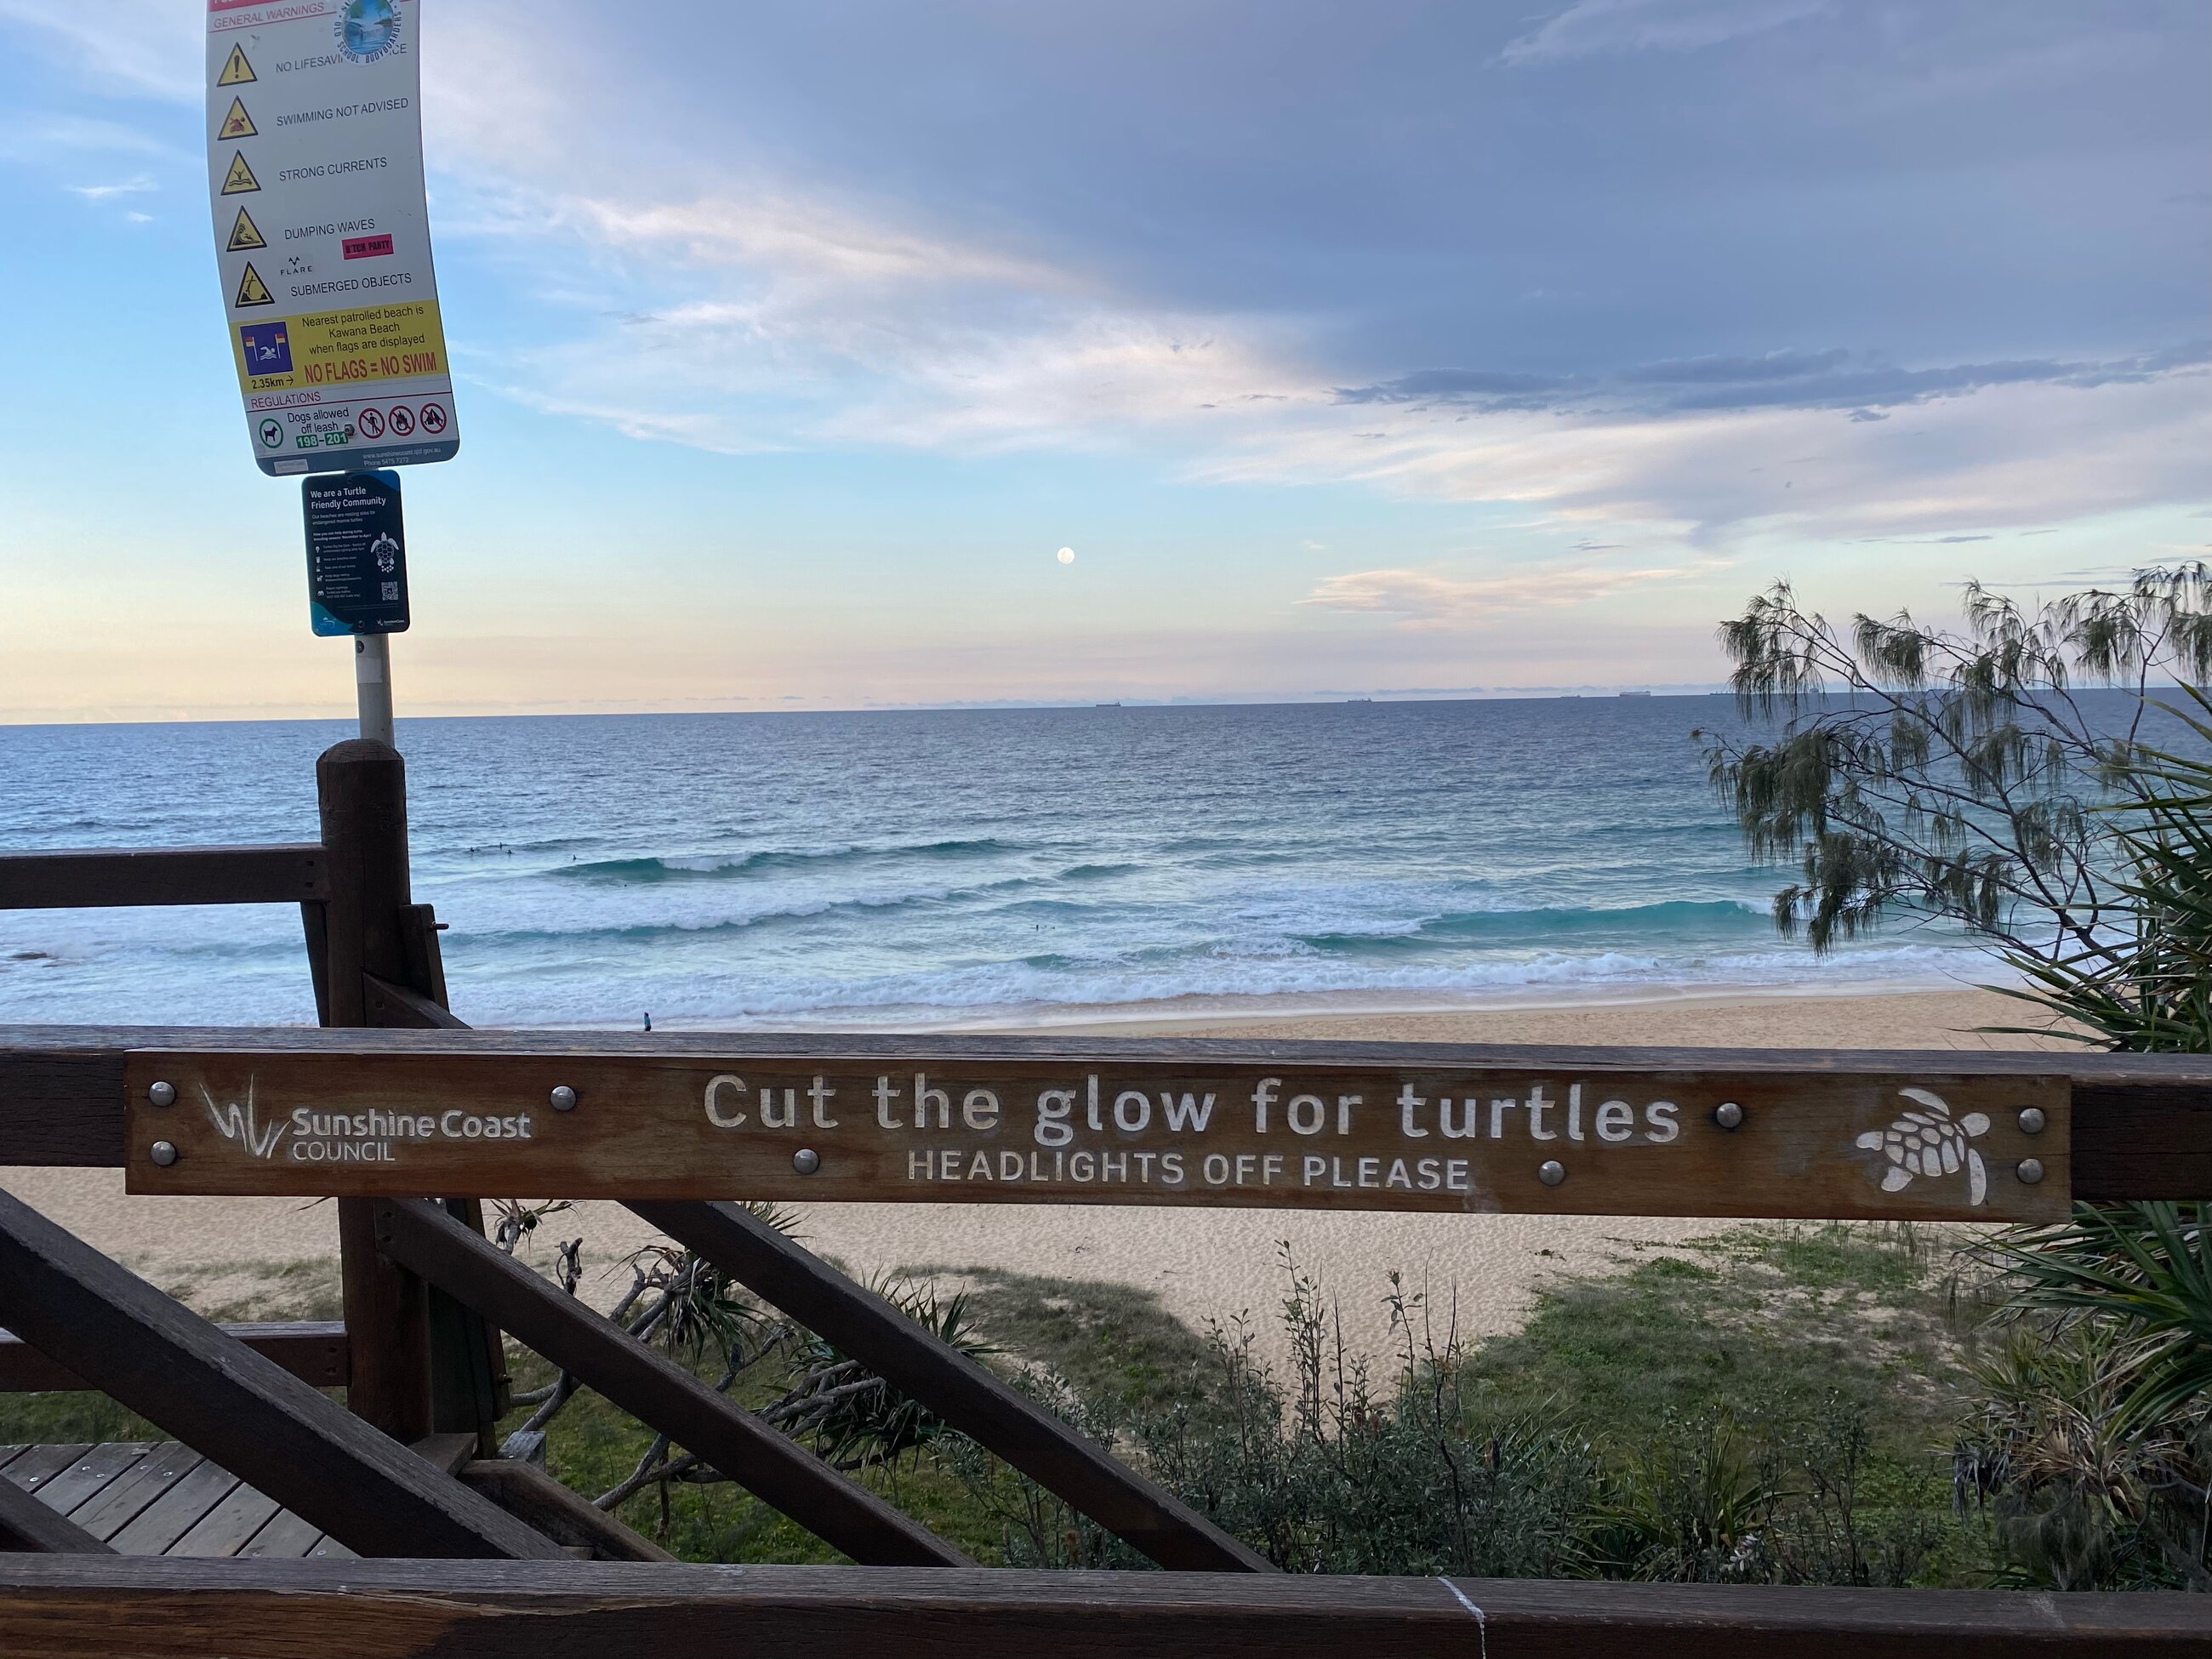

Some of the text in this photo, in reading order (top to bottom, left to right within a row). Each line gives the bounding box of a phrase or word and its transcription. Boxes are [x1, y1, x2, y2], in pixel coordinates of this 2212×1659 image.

[214, 12, 264, 28] GENERAL
[265, 2, 325, 20] WARNINGS
[337, 41, 360, 64] SCHOOL
[365, 11, 402, 64] BODYBOARDERS
[276, 61, 293, 73] NO
[276, 97, 409, 127] SWIMMING NOT ADVISED
[279, 157, 388, 182] STRONG CURRENTS
[284, 218, 376, 240] DUMPING WAVES
[280, 265, 313, 276] FLARE
[290, 272, 413, 297] SUBMERGED OBJECTS
[301, 305, 425, 328] Nearest patrolled beach is
[328, 322, 401, 339] Kawana Beach
[309, 334, 425, 356] when flags are displayed
[305, 351, 437, 384] NO FLAGS = NO SWIM
[252, 373, 284, 390] 2.35km
[250, 391, 322, 408] REGULATIONS
[287, 408, 350, 425] Dogs allowed
[301, 420, 339, 435] off leash
[310, 490, 322, 499] We
[344, 487, 367, 495] Turtle
[311, 496, 386, 510] Friendly Community
[705, 1073, 1680, 1148] Cut the glow for turtles
[292, 1106, 533, 1138] Sunshine Coast
[292, 1141, 396, 1161] COUNCIL
[907, 1149, 1473, 1193] HEADLIGHTS OFF PLEASE
